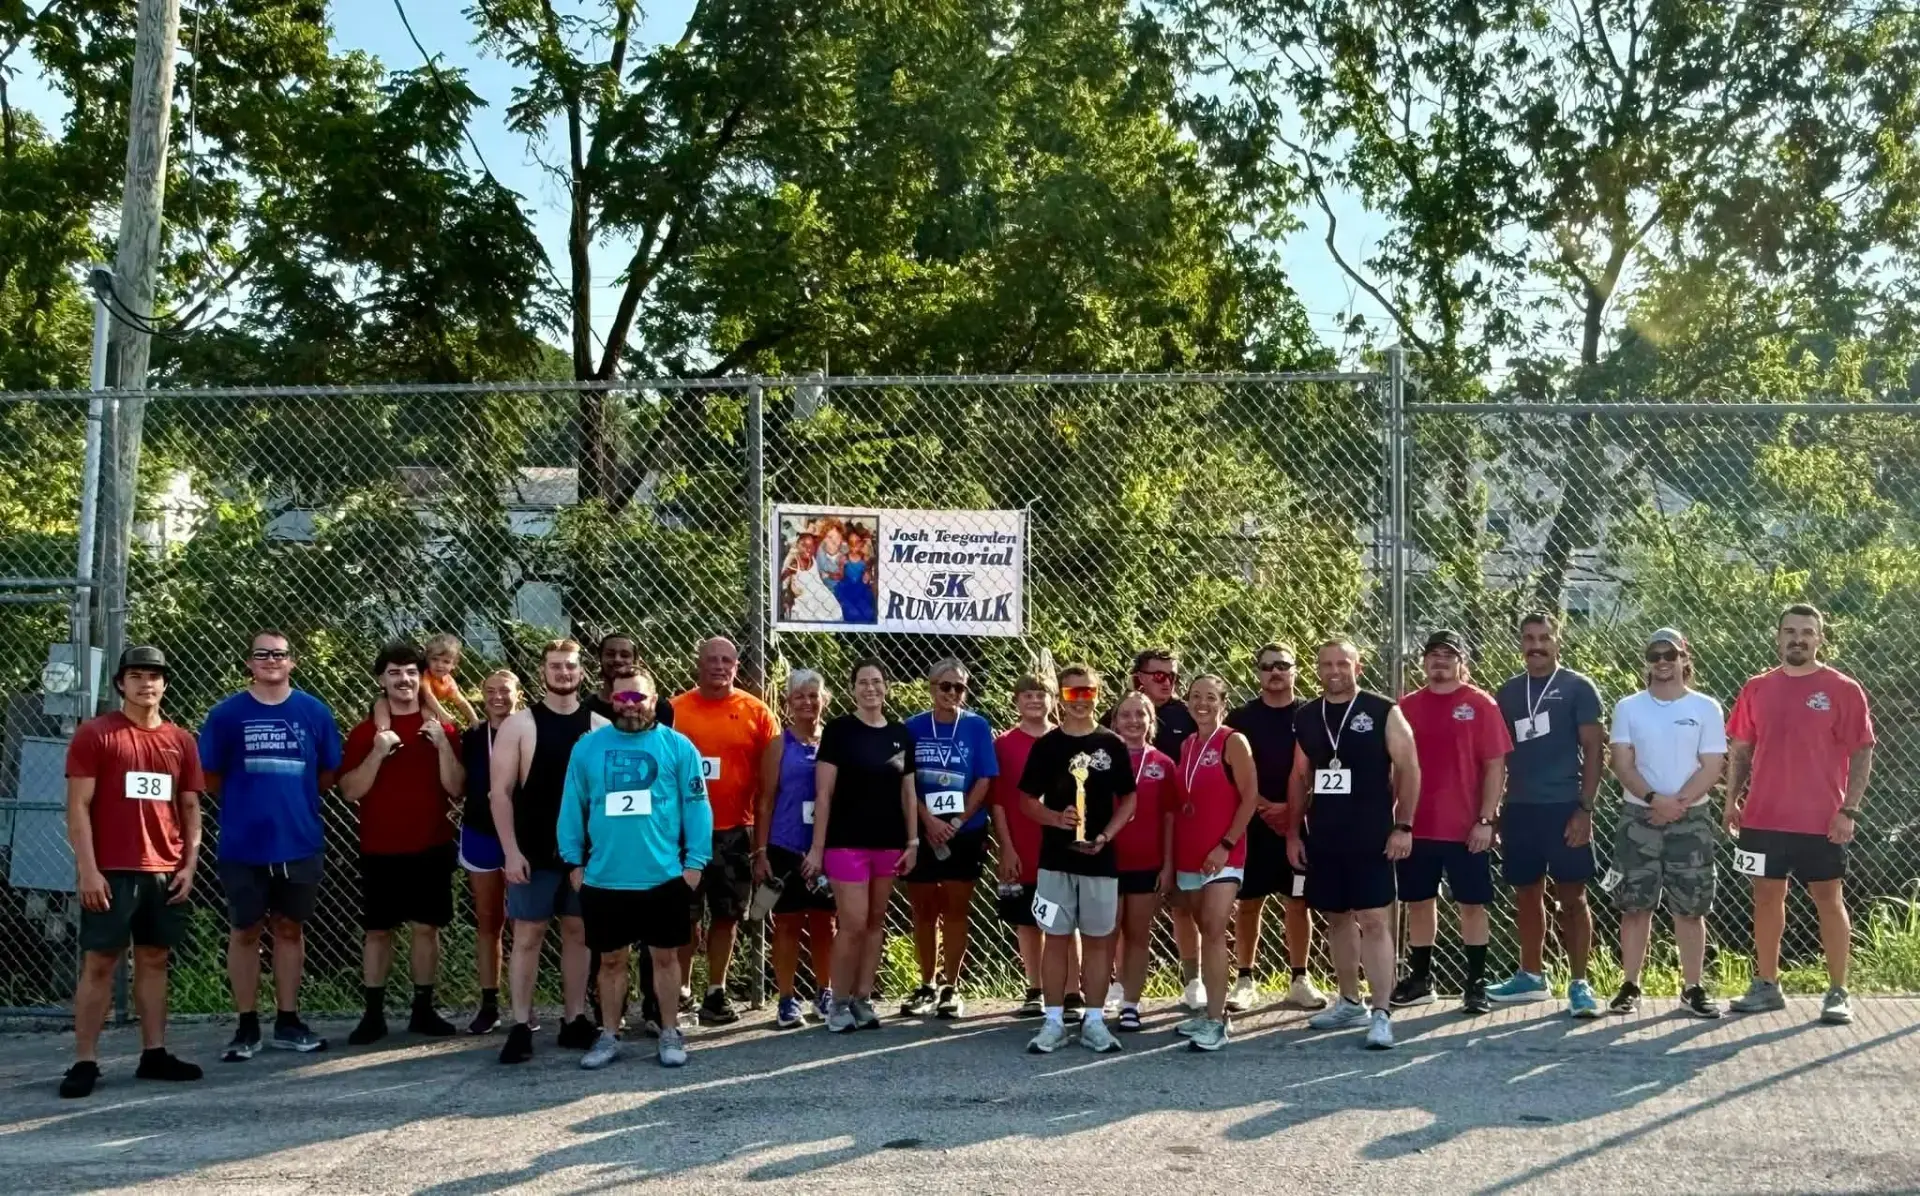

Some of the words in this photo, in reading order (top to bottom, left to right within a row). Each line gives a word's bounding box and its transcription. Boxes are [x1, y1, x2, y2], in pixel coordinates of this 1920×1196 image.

[889, 528, 929, 542] Josh
[934, 529, 1017, 547] Teegarden
[889, 544, 1013, 566] Memorial
[925, 572, 975, 599] 5K
[885, 589, 1013, 622] RUN/WALK
[136, 777, 162, 796] 38
[1321, 773, 1344, 790] 22
[621, 795, 635, 812] 2
[933, 794, 956, 811] 44
[1736, 854, 1756, 872] 42
